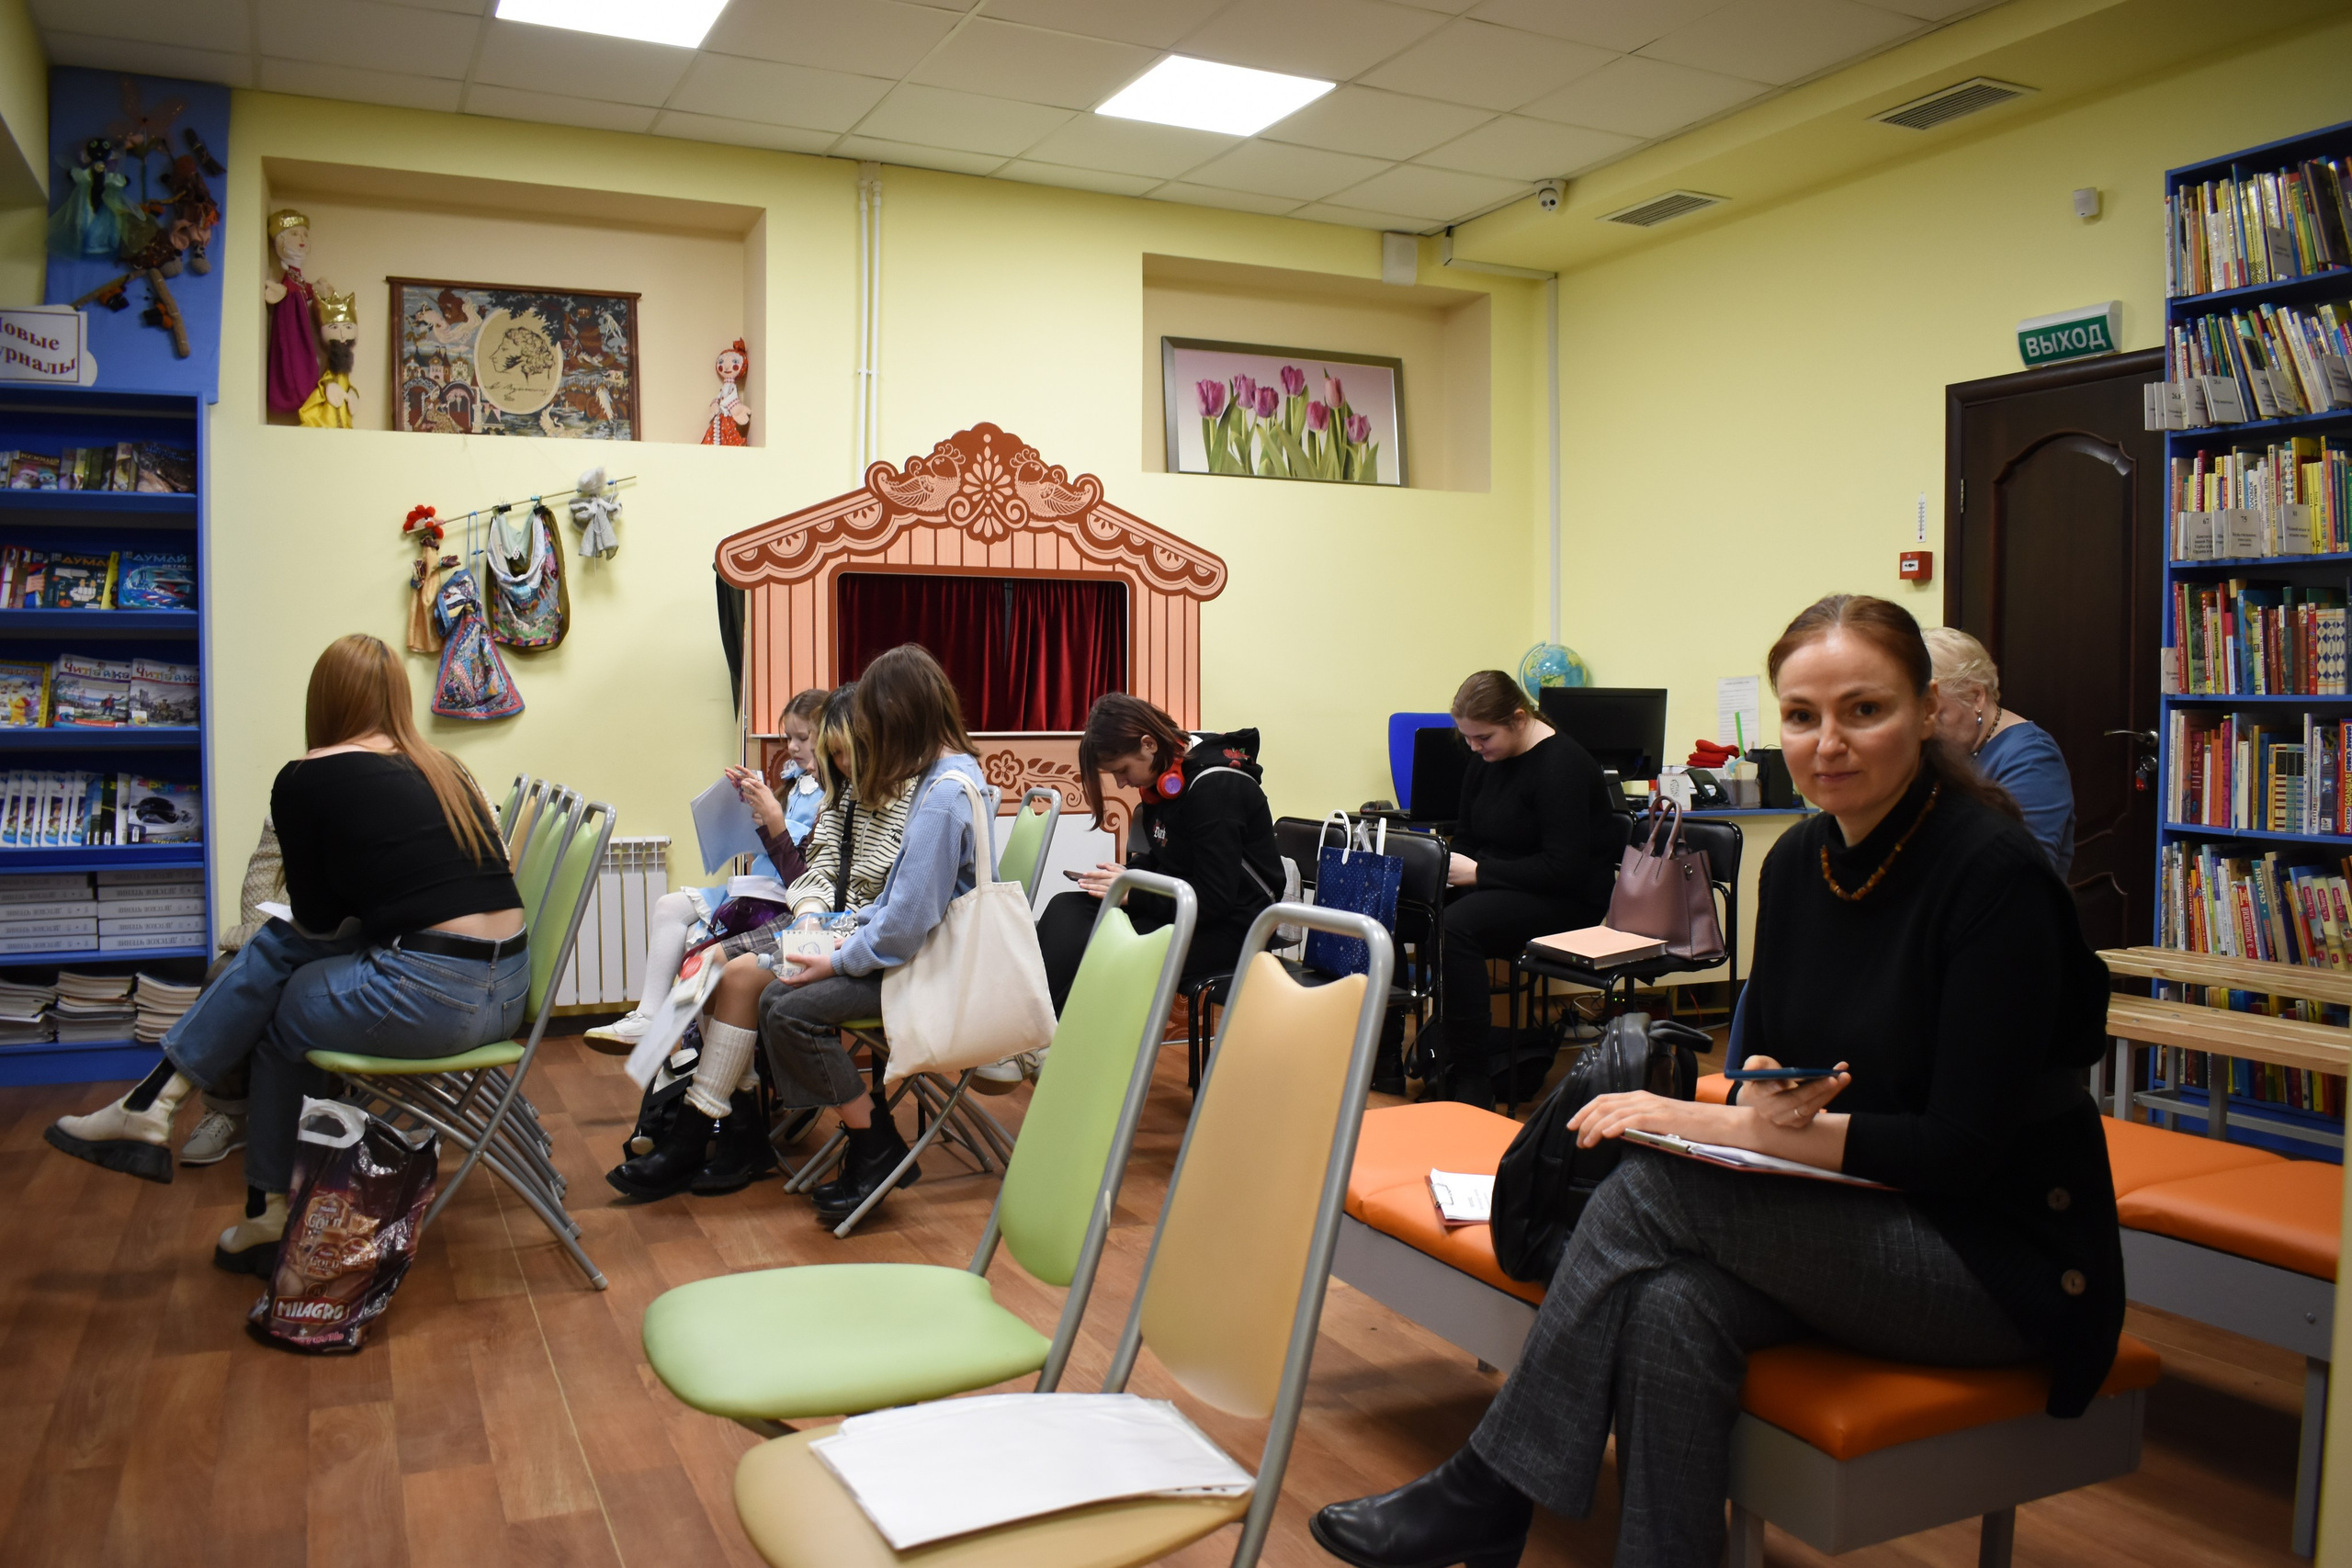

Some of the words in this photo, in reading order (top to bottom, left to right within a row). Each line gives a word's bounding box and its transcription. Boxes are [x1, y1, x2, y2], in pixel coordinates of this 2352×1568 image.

[0, 317, 60, 351] овые
[2025, 323, 2107, 357] ВЫХОД
[0, 345, 76, 375] рналы
[62, 556, 108, 567] ДУМА
[132, 553, 187, 563] ДУМАЙ
[2255, 868, 2267, 904] СКАЗКИ
[117, 938, 143, 947] ЧТЕНИЕ
[145, 937, 178, 945] ДЕТСКОЕ
[277, 1301, 344, 1321] MILAGRO
